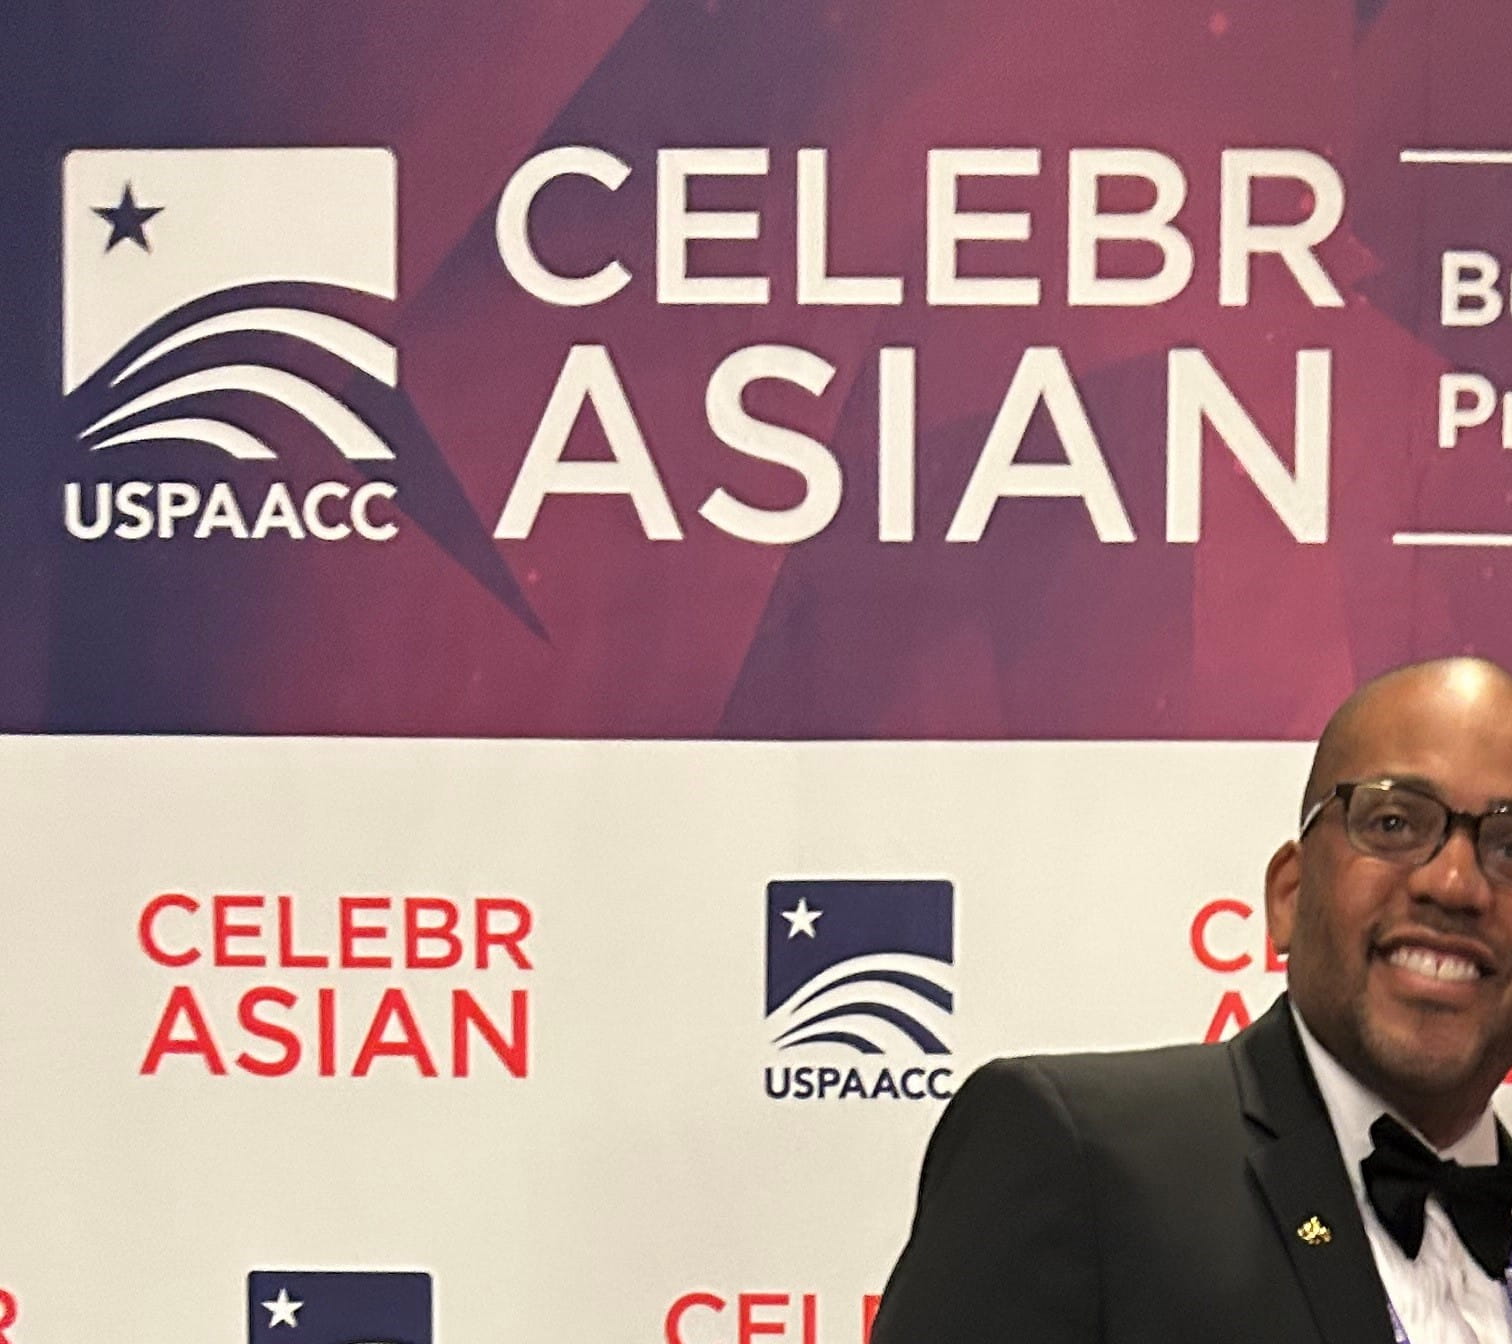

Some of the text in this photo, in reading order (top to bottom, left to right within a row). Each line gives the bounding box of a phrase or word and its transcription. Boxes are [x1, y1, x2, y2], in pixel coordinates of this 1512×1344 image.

[494, 145, 1346, 308] CELEBR
[493, 344, 1332, 545] ASIAN
[63, 480, 400, 543] USPAACC
[137, 893, 534, 971] CELEBR
[140, 984, 530, 1079] ASIAN
[764, 1067, 953, 1100] USPAACC
